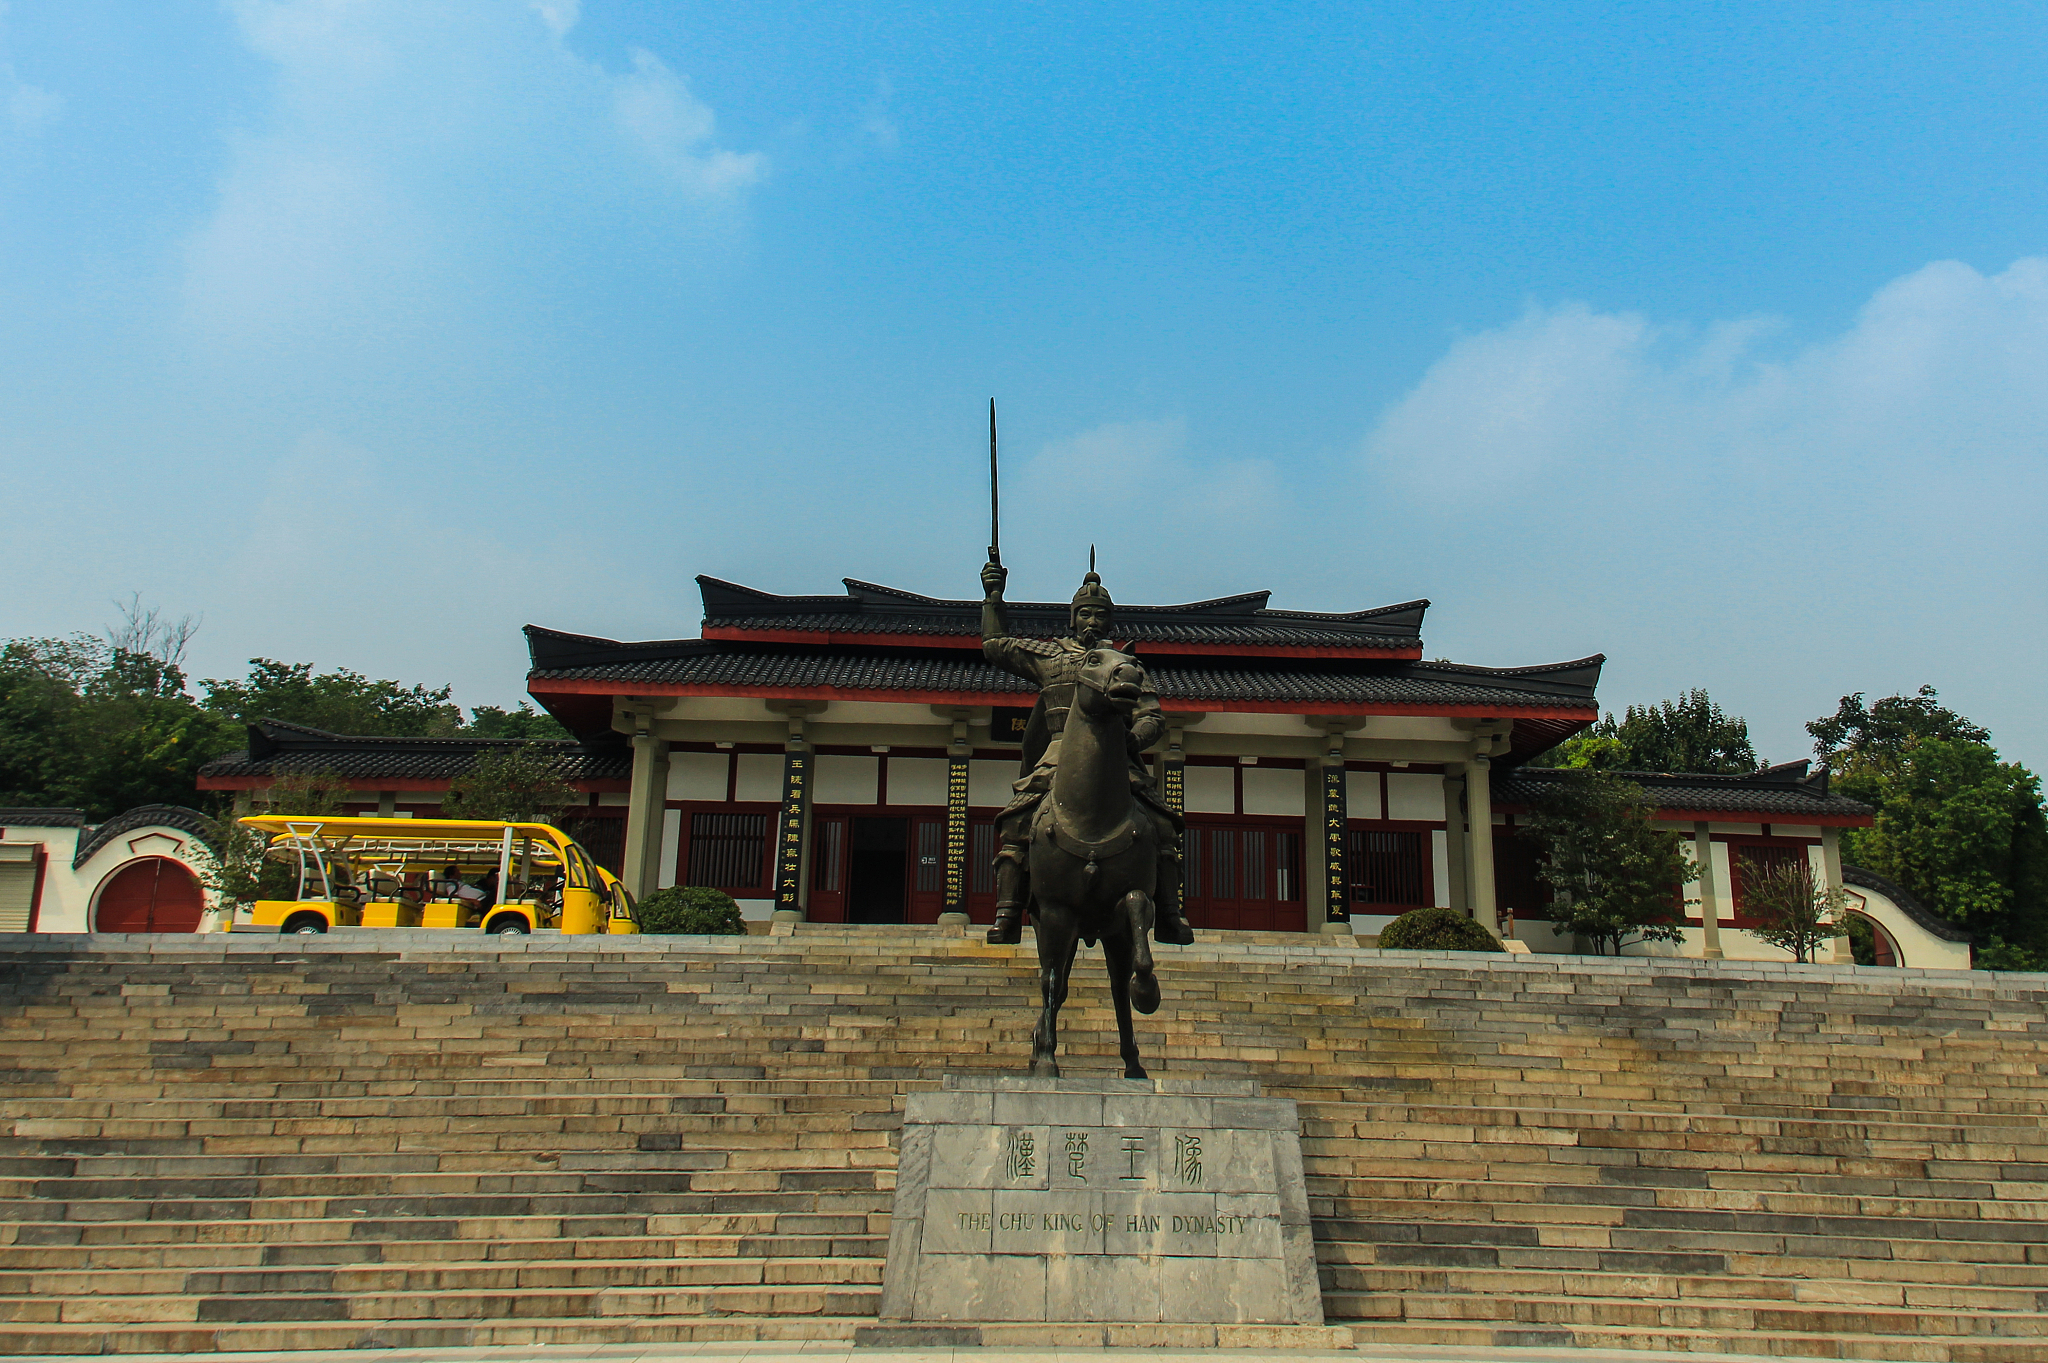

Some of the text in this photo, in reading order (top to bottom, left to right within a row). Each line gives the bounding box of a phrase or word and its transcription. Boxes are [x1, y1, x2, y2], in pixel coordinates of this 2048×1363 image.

[957, 1212, 1247, 1236] THE CHU KING OF HAN DYNASTY
